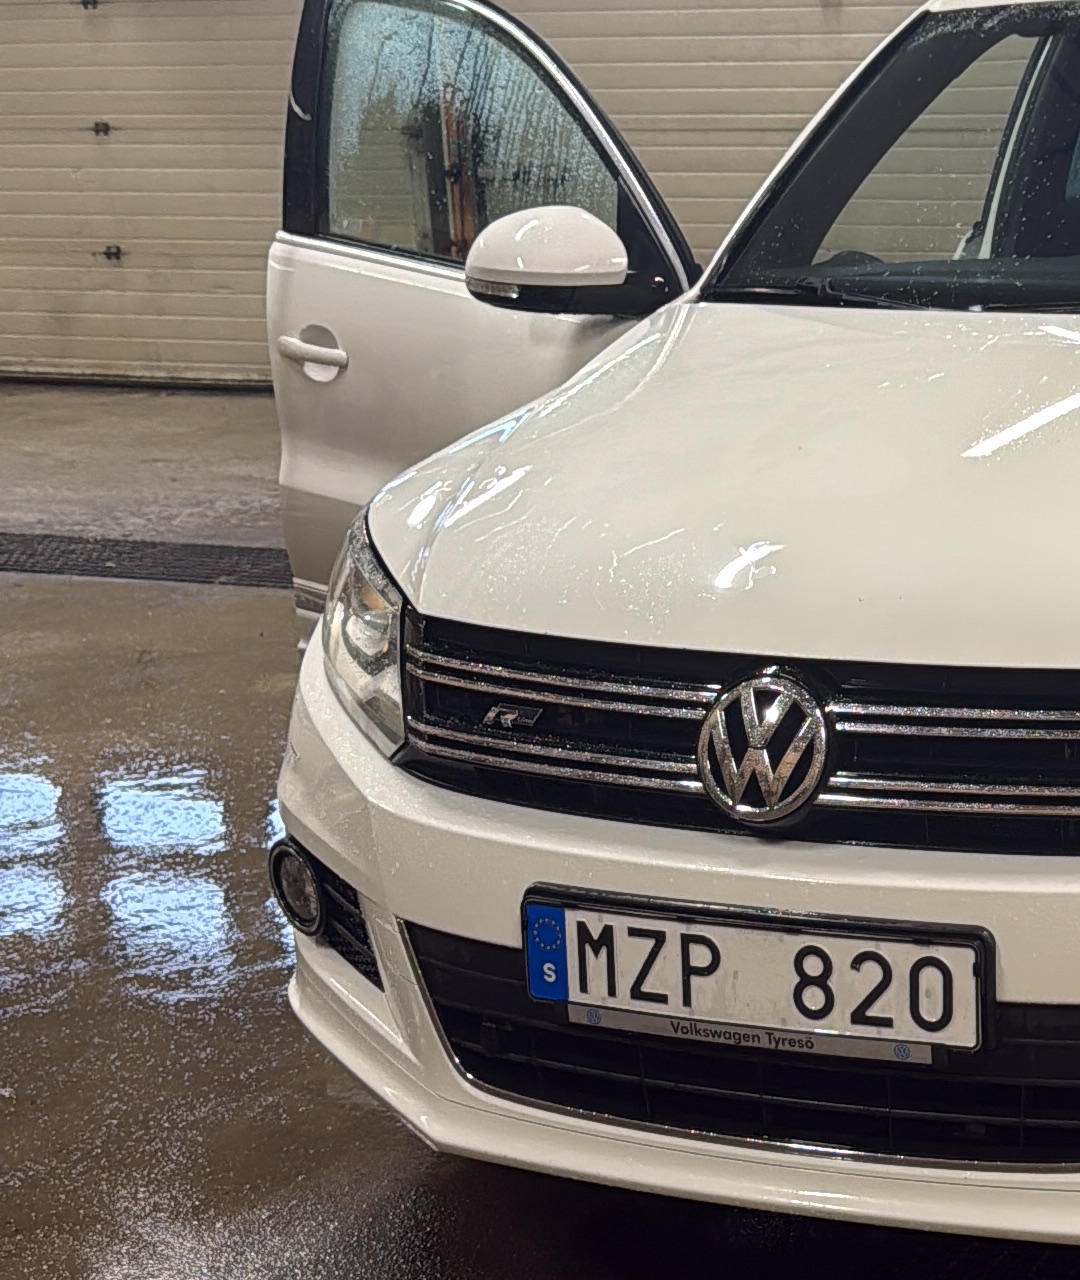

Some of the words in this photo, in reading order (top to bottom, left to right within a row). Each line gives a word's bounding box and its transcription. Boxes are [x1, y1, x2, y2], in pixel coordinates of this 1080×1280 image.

[543, 962, 556, 983] S
[576, 921, 721, 1008] MZP
[792, 945, 954, 1033] 820
[669, 1021, 761, 1045] Volkswagen
[765, 1032, 815, 1050] Tyresö
